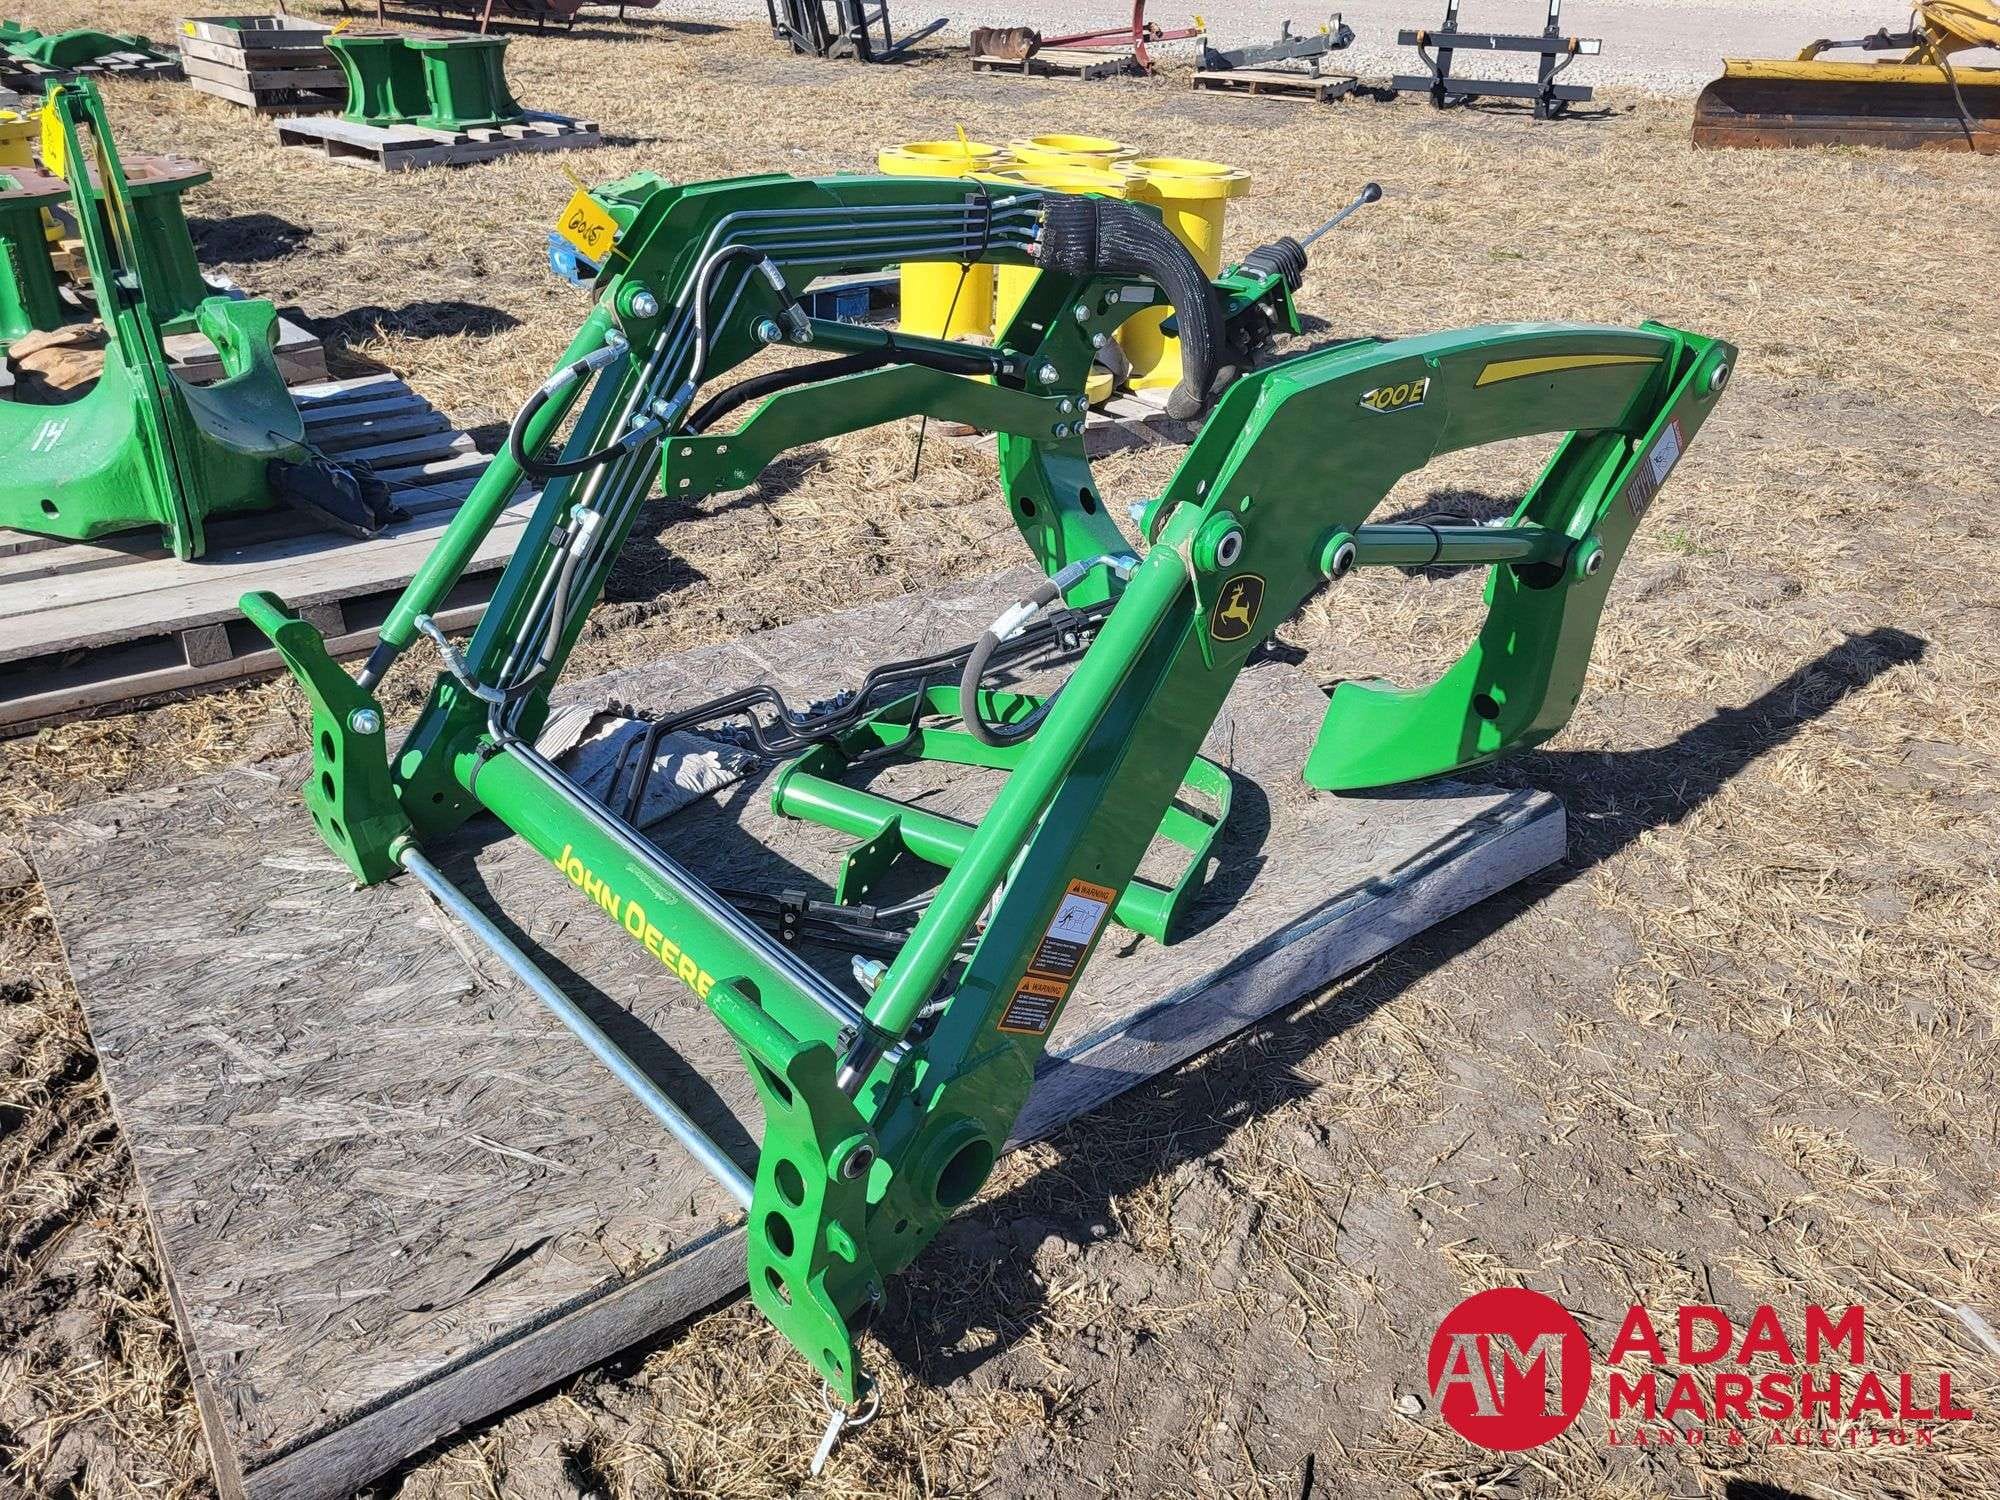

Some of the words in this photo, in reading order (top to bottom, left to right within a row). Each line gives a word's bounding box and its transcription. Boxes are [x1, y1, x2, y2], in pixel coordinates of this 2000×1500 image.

[1080, 885, 1110, 899] WARNING
[554, 843, 622, 921] JOHN
[624, 900, 717, 1000] DEERE
[1032, 982, 1063, 995] WARNING
